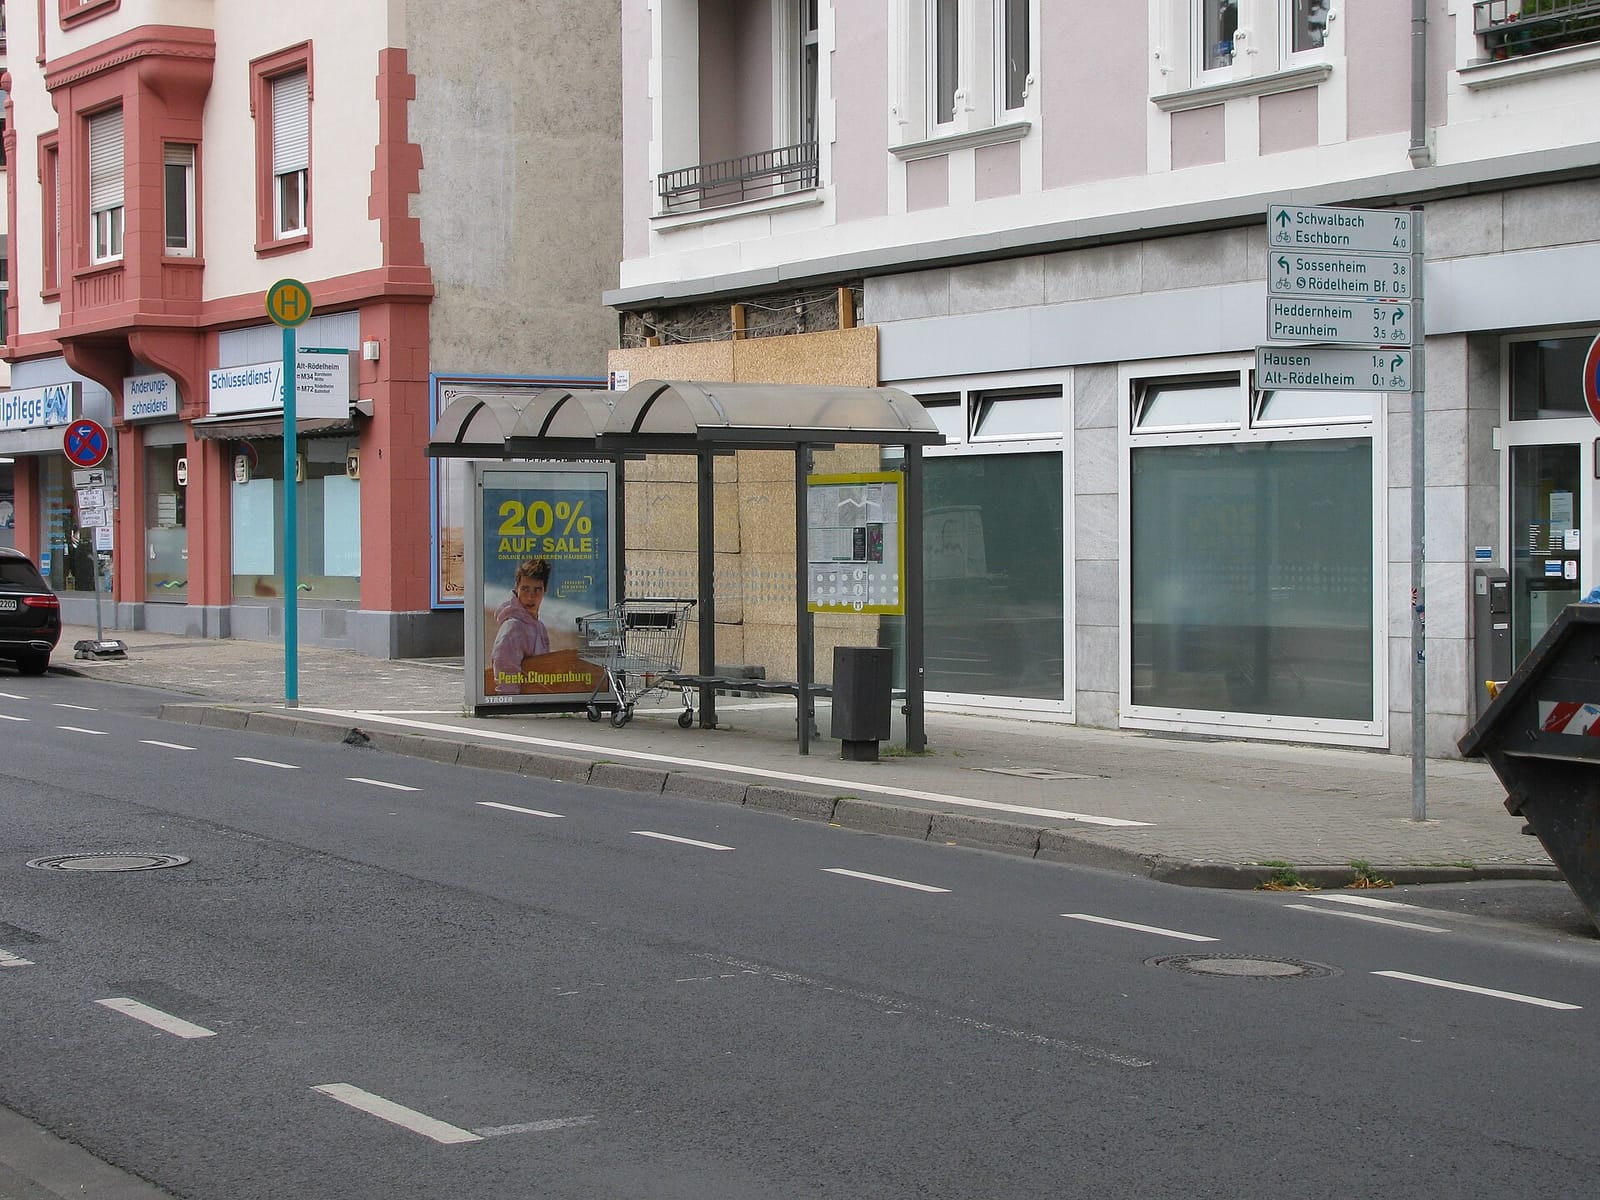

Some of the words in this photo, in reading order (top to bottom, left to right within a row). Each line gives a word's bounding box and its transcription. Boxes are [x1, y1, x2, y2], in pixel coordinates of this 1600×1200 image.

[1296, 212, 1365, 227] Schwalbach
[1296, 230, 1350, 245] Eschborn
[1296, 258, 1366, 273] Sossenheim
[1308, 277, 1369, 291] Rödelheim
[1374, 280, 1388, 292] Bf.
[281, 289, 299, 317] H
[1274, 303, 1352, 319] Heddernheim
[1274, 322, 1338, 336] Praunheim
[297, 362, 340, 371] Alt-Rödelheim
[1264, 353, 1311, 366] Hausen
[211, 367, 272, 390] Schlüsseldienst
[1264, 371, 1355, 386] Alt-Rödelheim
[132, 397, 168, 415] schneiderei
[498, 500, 592, 536] 20%
[498, 538, 537, 553] AUF
[542, 538, 593, 553] SALE
[498, 671, 524, 684] Peek
[528, 671, 592, 685] Cloppenburg
